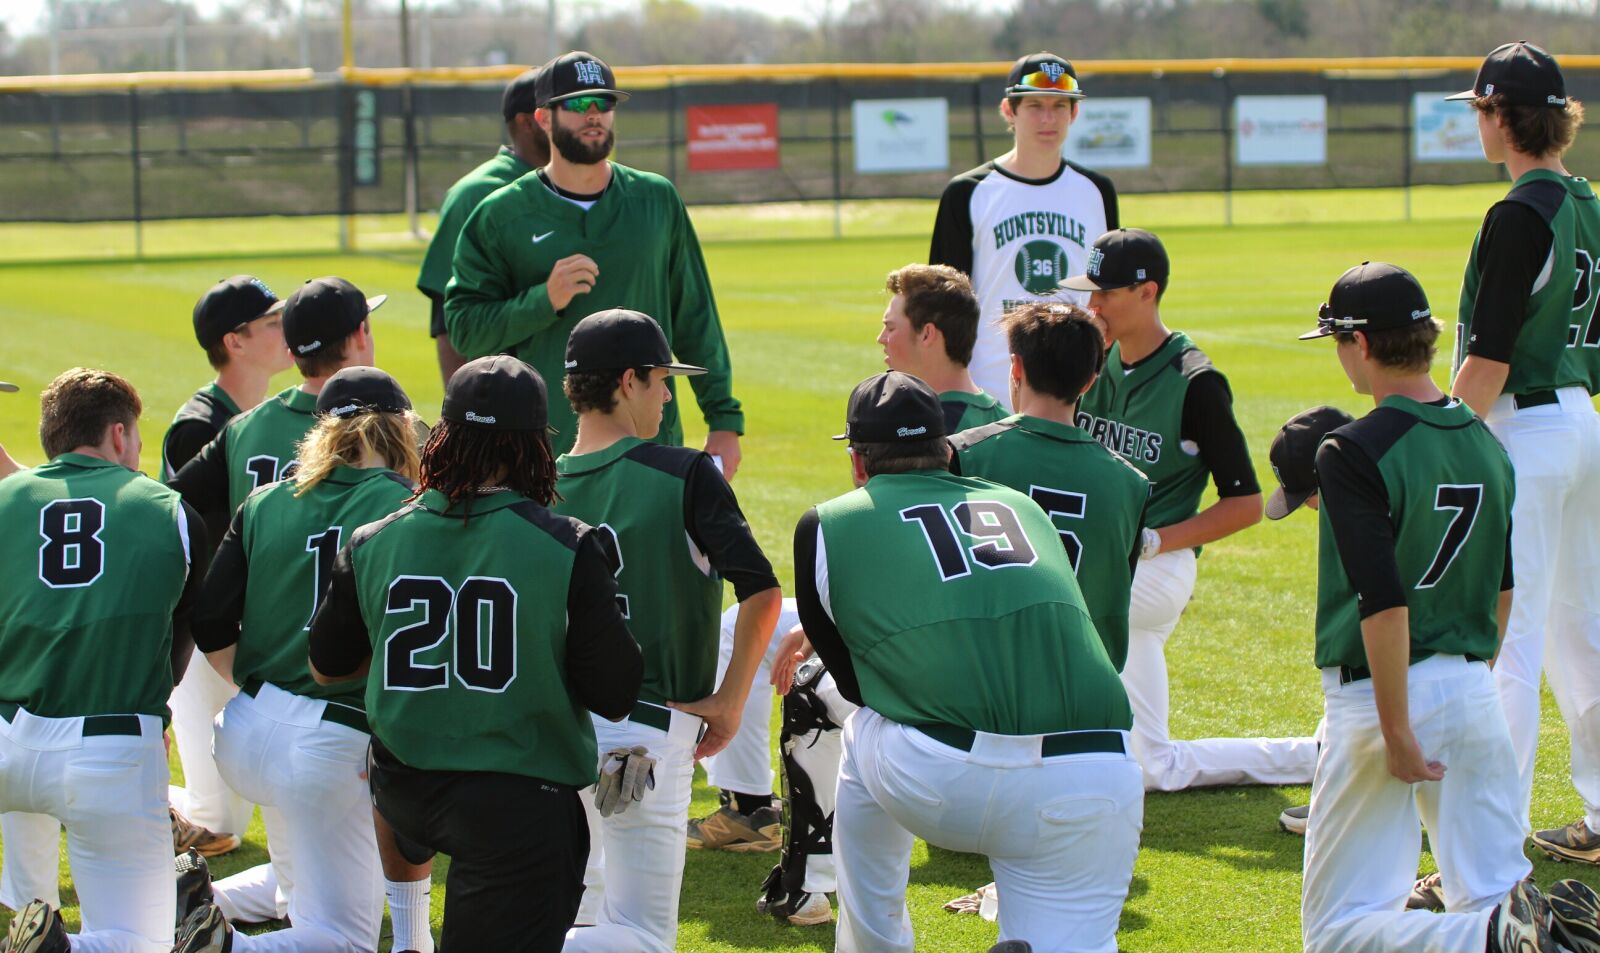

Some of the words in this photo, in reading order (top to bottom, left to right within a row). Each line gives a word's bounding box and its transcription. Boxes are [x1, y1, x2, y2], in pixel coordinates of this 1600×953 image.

[993, 211, 1086, 250] HUNTSVILLE
[1032, 259, 1053, 276] 36
[1076, 411, 1163, 464] ORNETS
[38, 497, 106, 589] 8
[898, 501, 1039, 582] 19
[1028, 484, 1087, 577] 5
[1414, 483, 1484, 590] 7
[383, 574, 519, 694] 20
